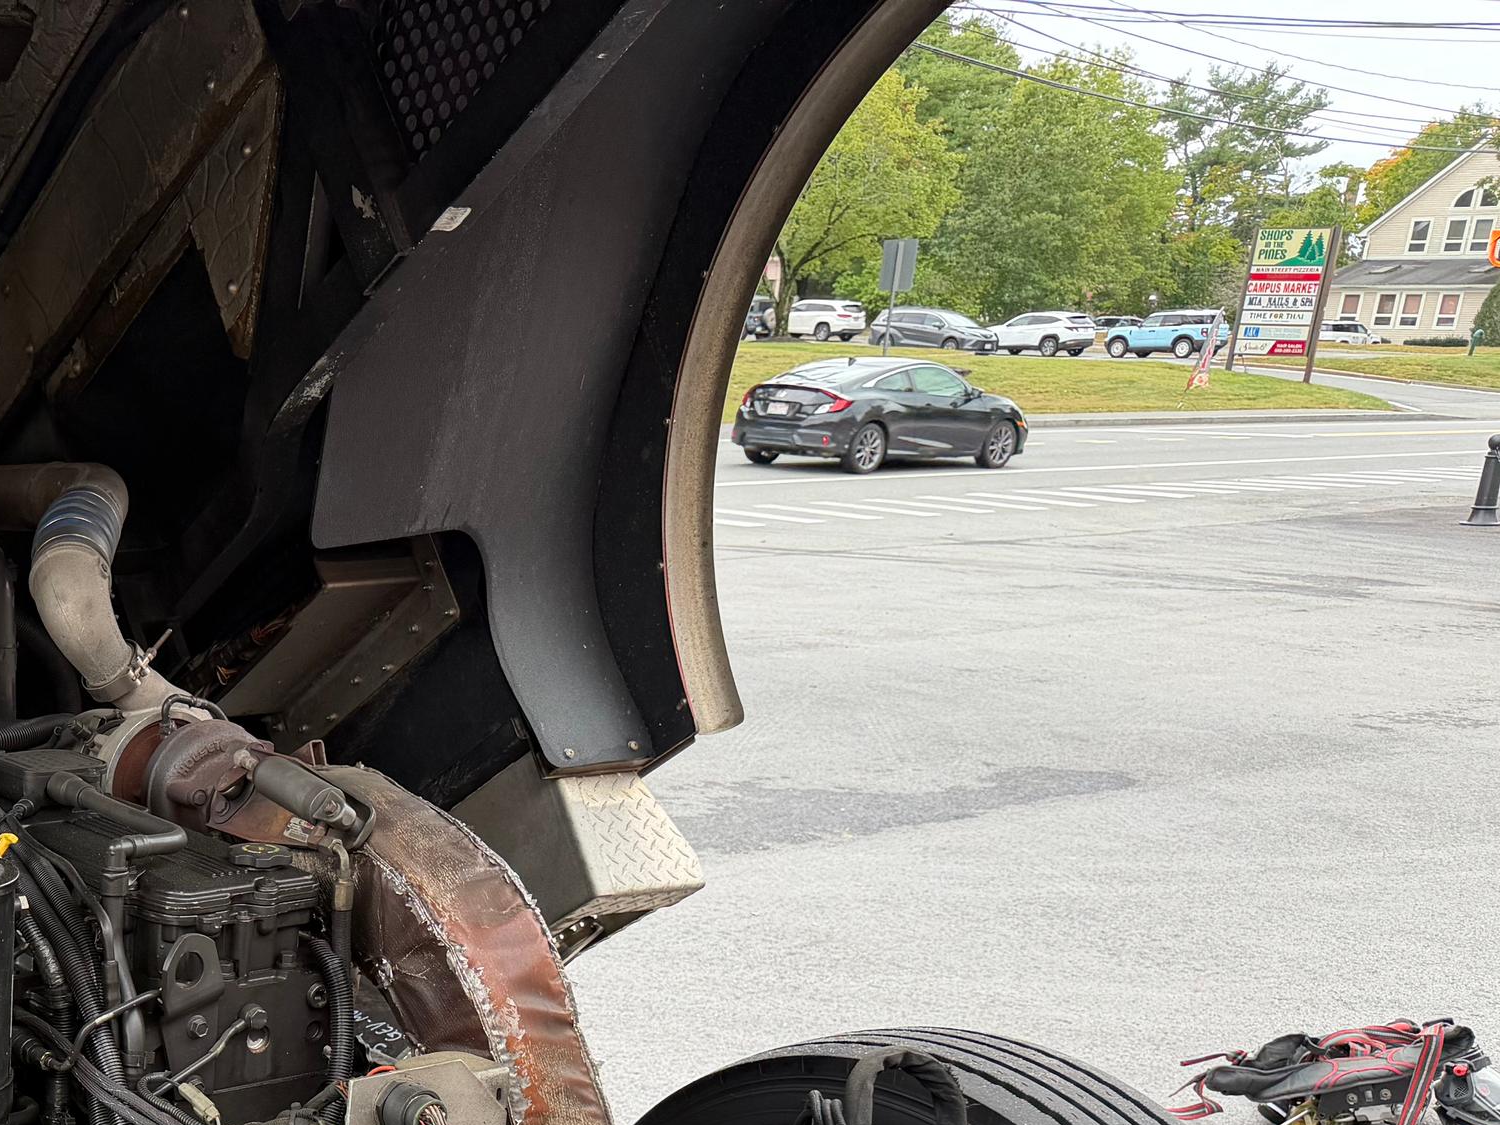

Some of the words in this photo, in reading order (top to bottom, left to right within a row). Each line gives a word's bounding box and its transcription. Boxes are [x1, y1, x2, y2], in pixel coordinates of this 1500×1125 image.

[1260, 230, 1294, 241] SHOPS
[1258, 249, 1288, 260] PINES
[1248, 283, 1282, 293] CAMPUS
[1283, 283, 1320, 293] MARKET
[1247, 297, 1262, 306] MIA
[1267, 297, 1289, 307] NAILS
[1292, 298, 1299, 306] &
[1300, 297, 1313, 306] SPA
